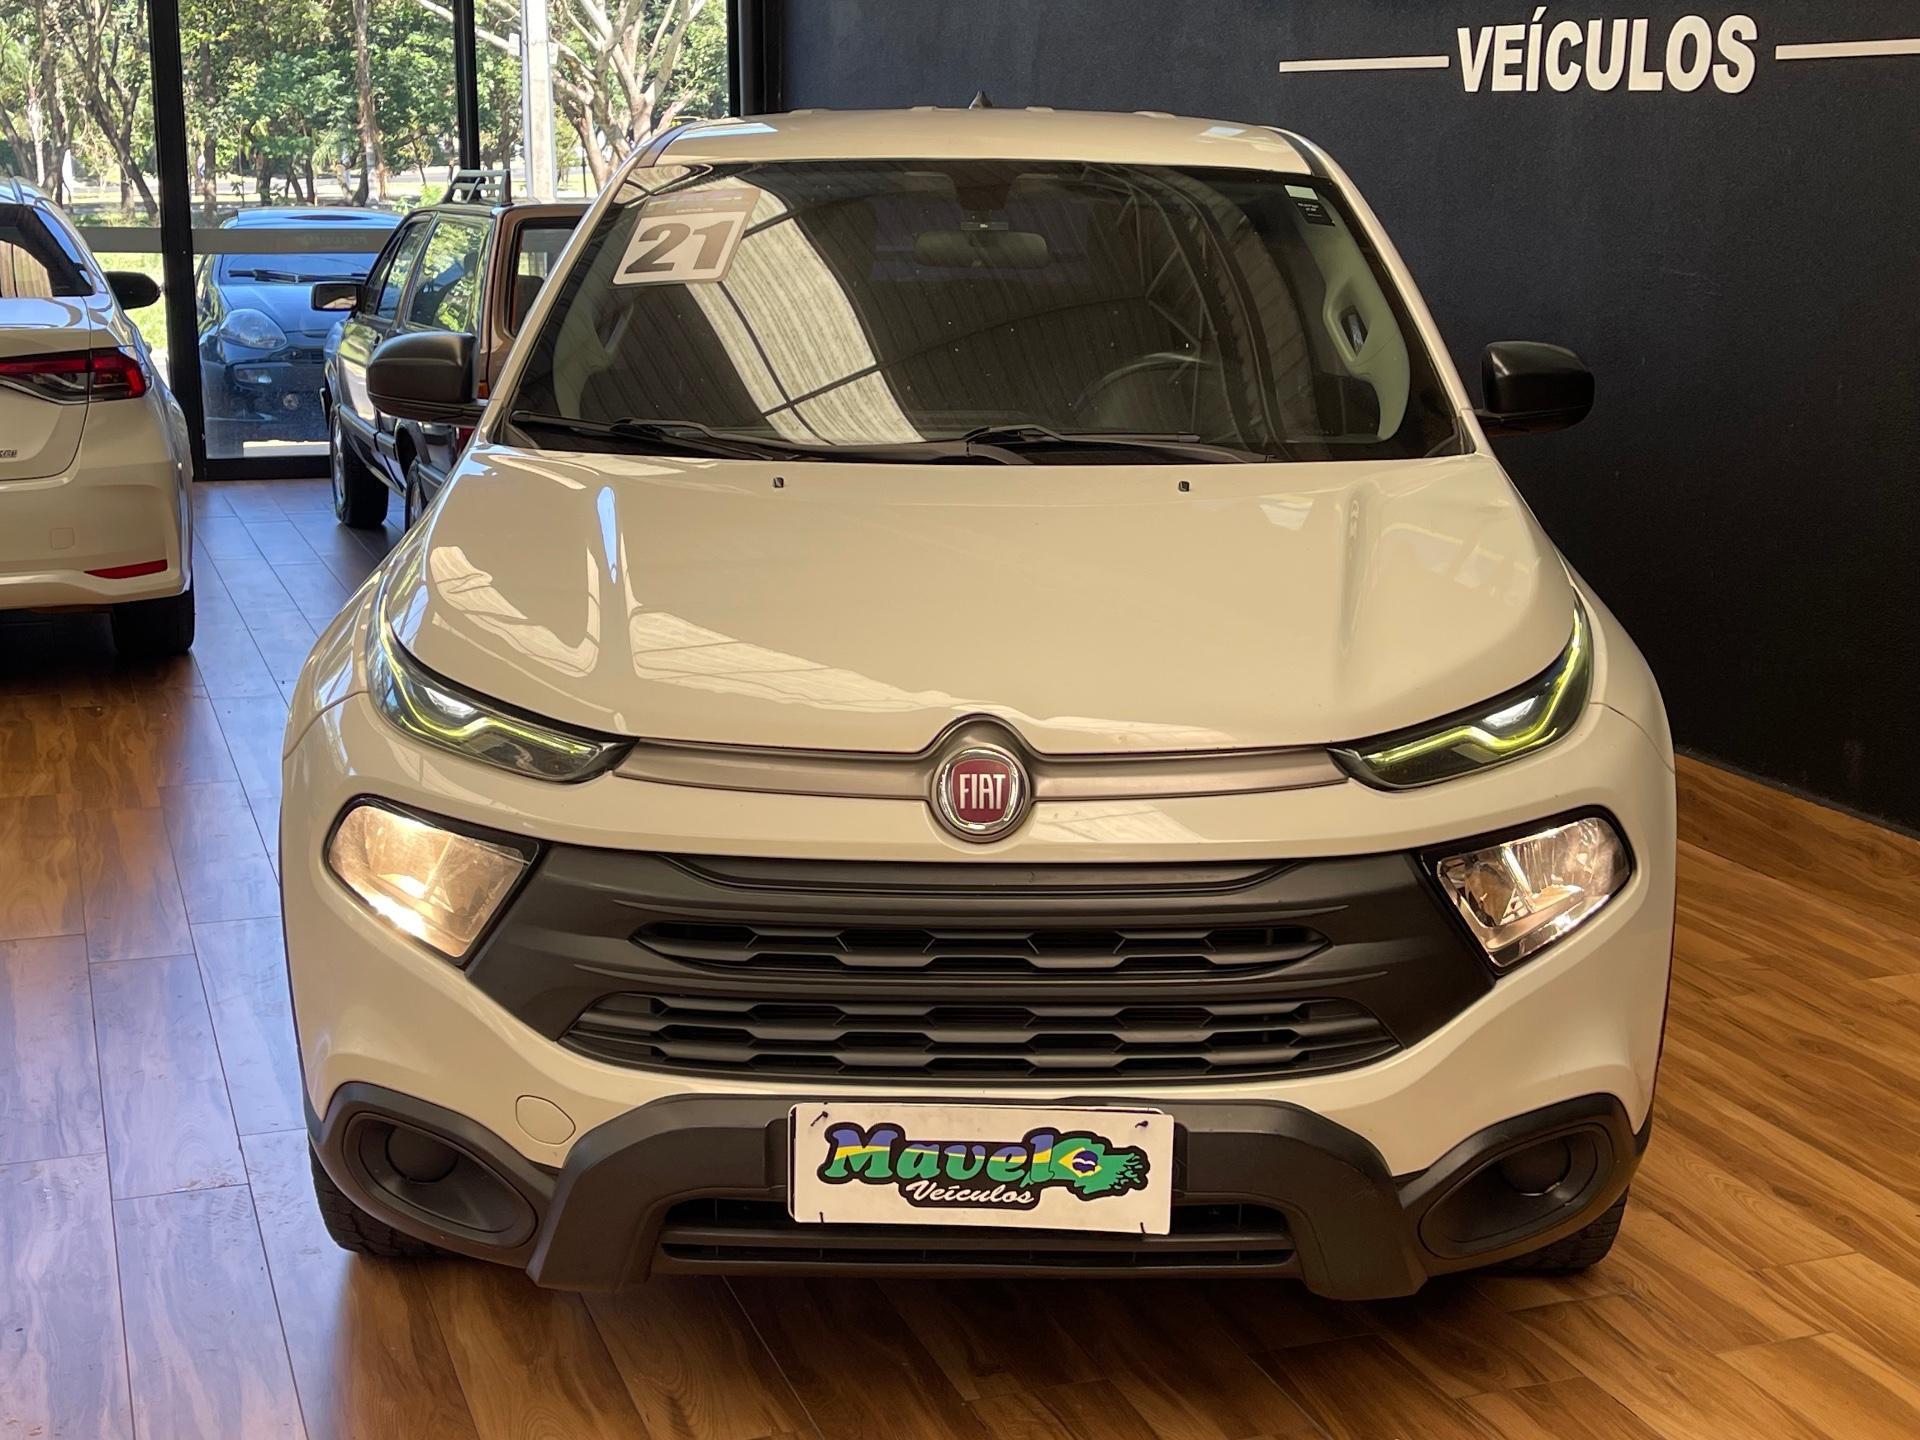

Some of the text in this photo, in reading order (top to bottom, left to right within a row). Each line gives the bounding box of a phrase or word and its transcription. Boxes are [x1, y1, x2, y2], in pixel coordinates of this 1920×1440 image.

[1457, 6, 1757, 93] VEÍCULOS
[624, 220, 734, 274] 21
[959, 773, 1006, 809] FIAT
[905, 1180, 1034, 1204] Veículos
